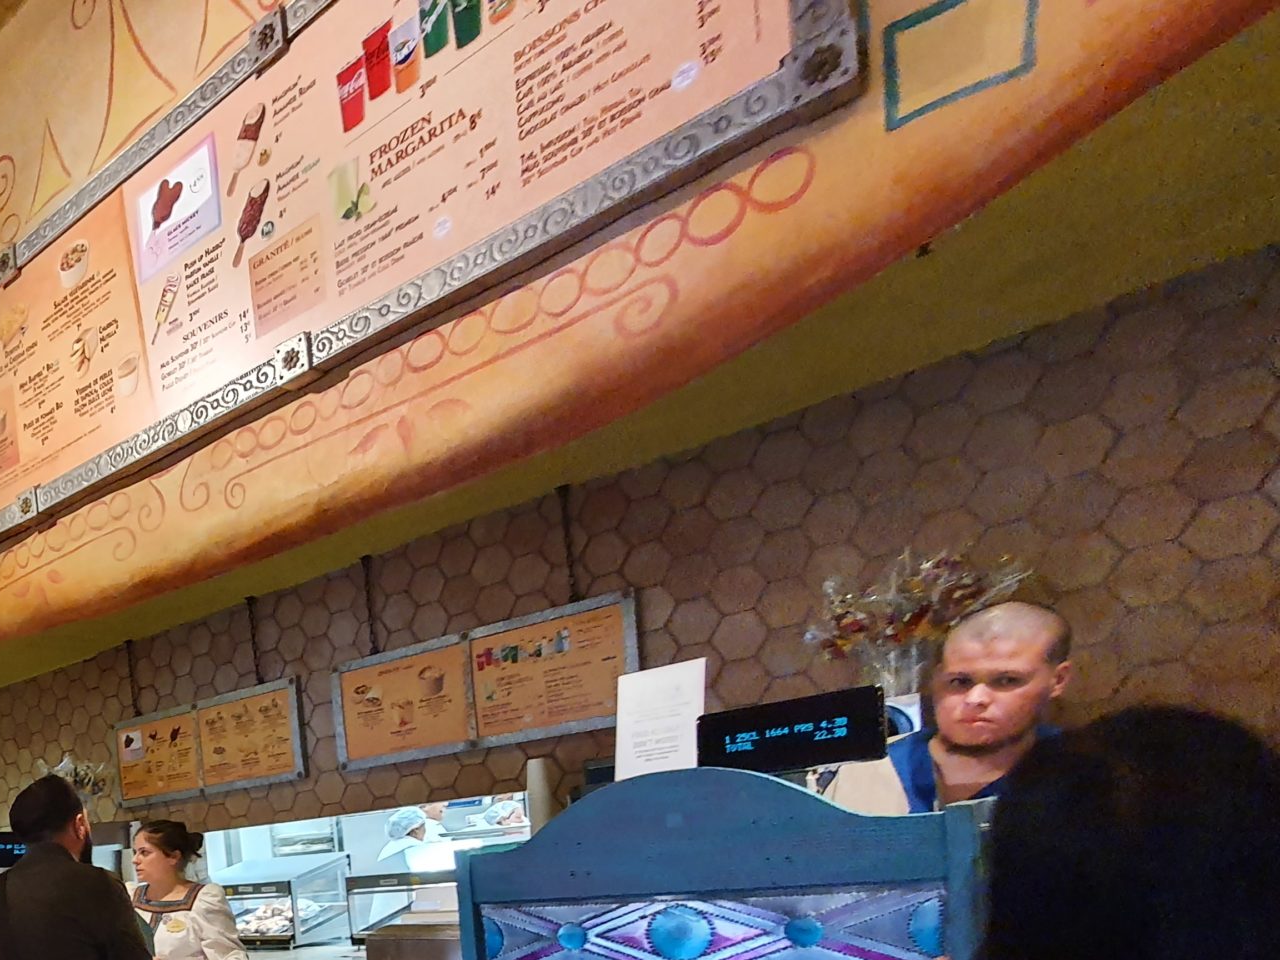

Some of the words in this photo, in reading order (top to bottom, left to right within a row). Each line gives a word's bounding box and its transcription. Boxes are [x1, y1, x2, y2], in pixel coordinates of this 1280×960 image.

[513, 10, 581, 62] BOISSONS
[368, 110, 433, 165] FROZEN
[370, 108, 467, 182] MARGARITA
[182, 308, 229, 343] SOUVENIRS
[725, 736, 730, 744] 1
[765, 727, 789, 737] 1664
[725, 741, 754, 753] TOTAL
